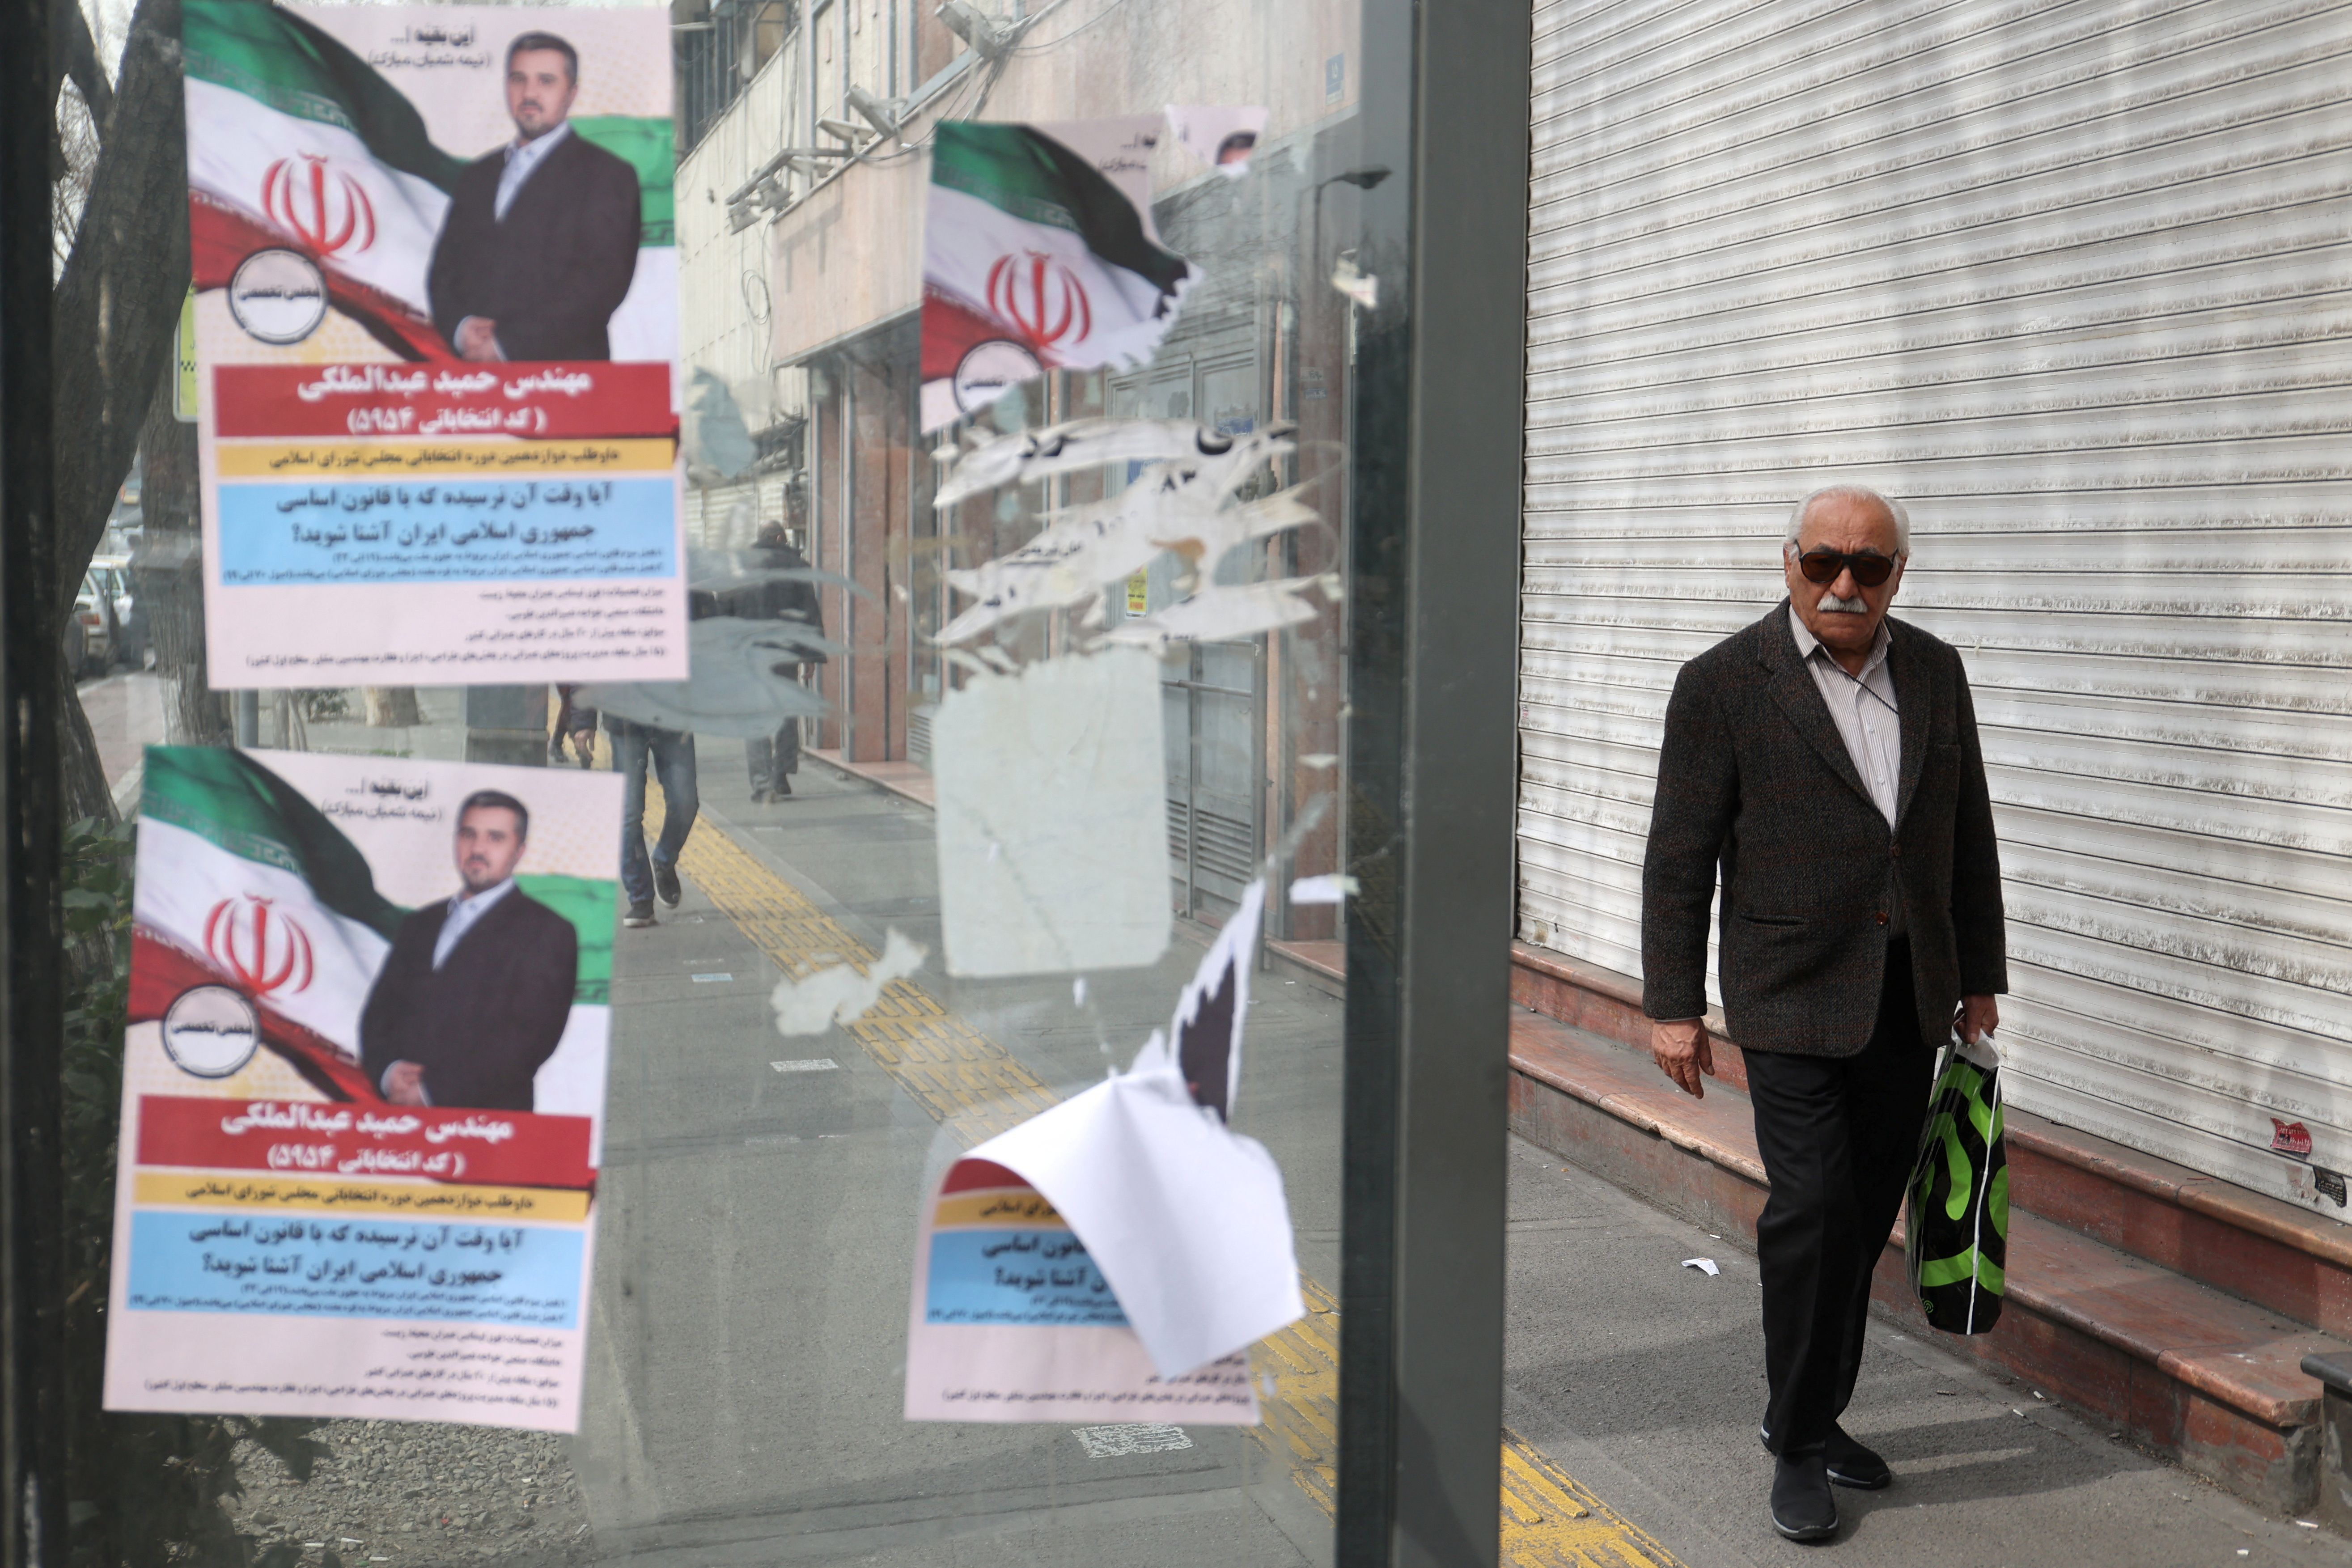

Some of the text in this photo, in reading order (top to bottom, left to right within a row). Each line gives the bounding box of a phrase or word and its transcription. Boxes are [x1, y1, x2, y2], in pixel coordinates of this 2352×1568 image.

[296, 363, 591, 401] مهندس حمید عبدالملکی
[418, 406, 499, 434] انتخاباتی
[269, 447, 619, 468] داوطلب دوازدهمین دوره انتخاباتی مجلس شورای اسلامی
[275, 480, 612, 513] آیا وقت آن نرسیده که با قانون اساسی
[292, 519, 595, 547] جمهوری اسلامی ایران آشنا شوید؟
[220, 1101, 513, 1146] مهندس حمید عبدالملکی
[337, 1147, 420, 1175] انتخاباتی
[186, 1182, 534, 1210] داوطلب دوازدهمین دوره انتخاباتی مجلس شورای اسلامی
[189, 1217, 523, 1254] آیا وقت آن نرسیده که با قانون اساسی
[981, 1233, 1040, 1259] اساسی
[202, 1250, 502, 1289] جمهوری اسلامی ایران آشنا شوید؟
[994, 1265, 1046, 1292] شوید؟
[1049, 1265, 1087, 1286] آشنا
